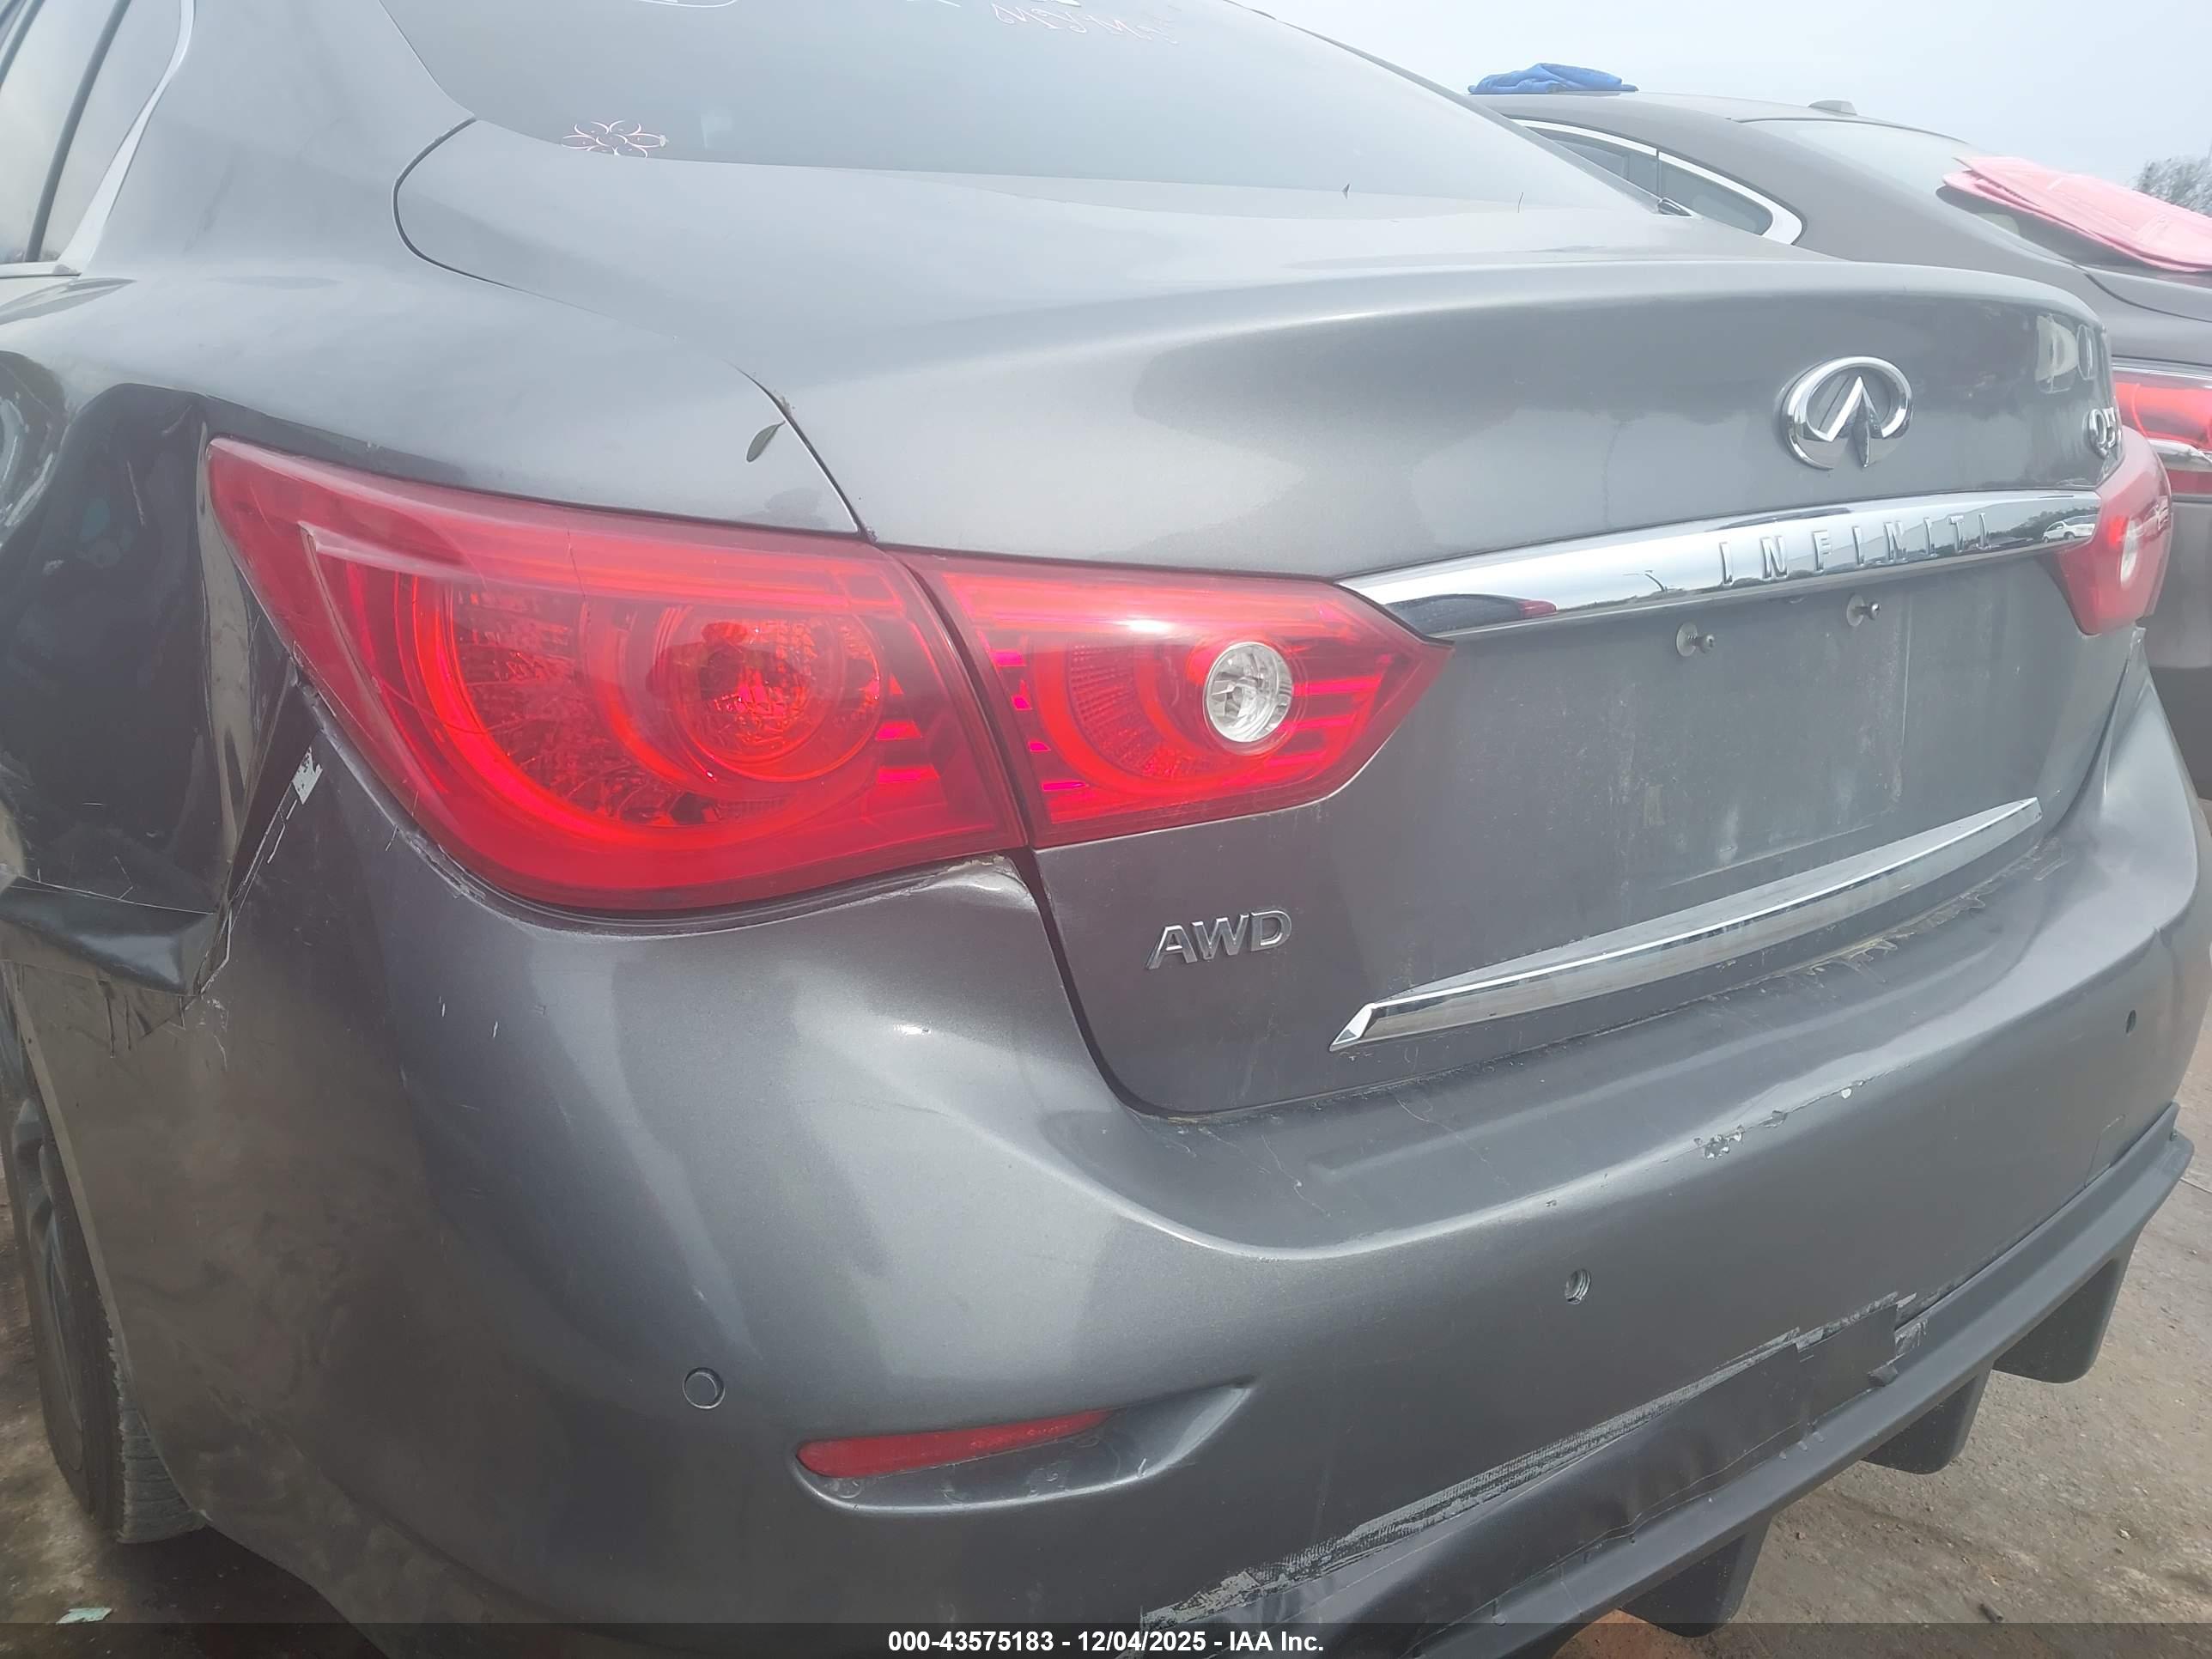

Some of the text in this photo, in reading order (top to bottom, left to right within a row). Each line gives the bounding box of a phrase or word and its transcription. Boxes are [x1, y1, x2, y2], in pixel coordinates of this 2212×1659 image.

[2088, 407, 2123, 457] Q5
[1718, 513, 1987, 586] INFINITI
[1146, 910, 1292, 969] AWD
